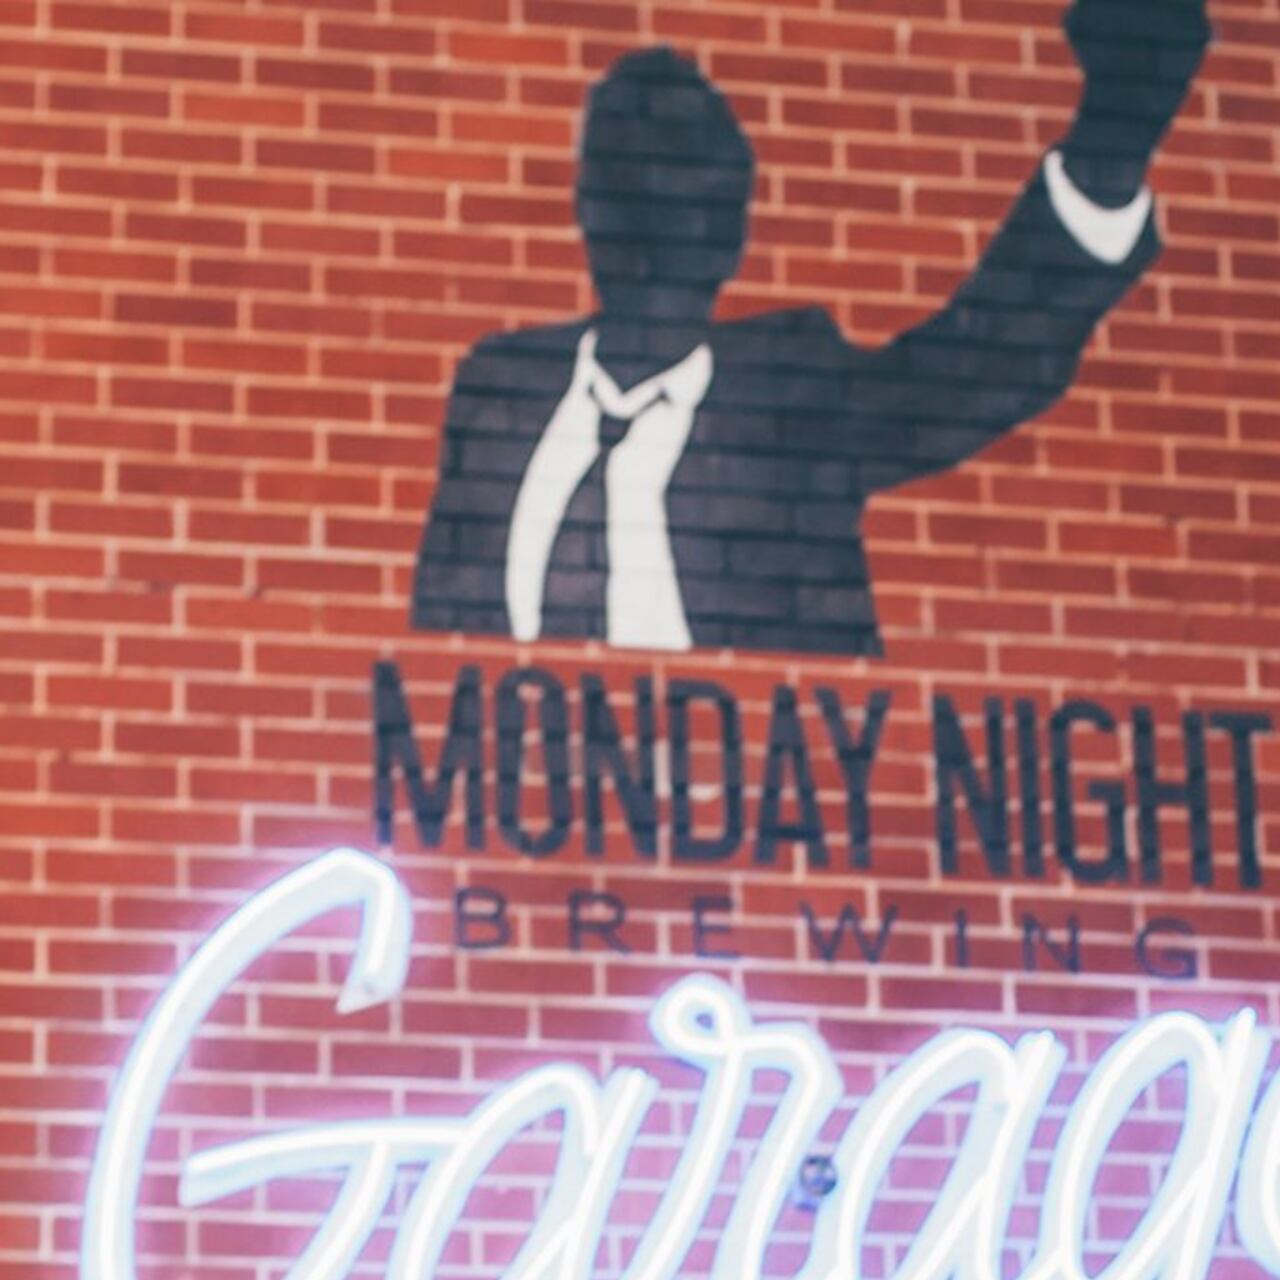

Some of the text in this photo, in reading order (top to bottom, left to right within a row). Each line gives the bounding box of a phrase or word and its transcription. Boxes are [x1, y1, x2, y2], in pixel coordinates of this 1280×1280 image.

[374, 661, 1274, 888] MONDAY NIGHT
[455, 887, 1199, 980] BREWING
